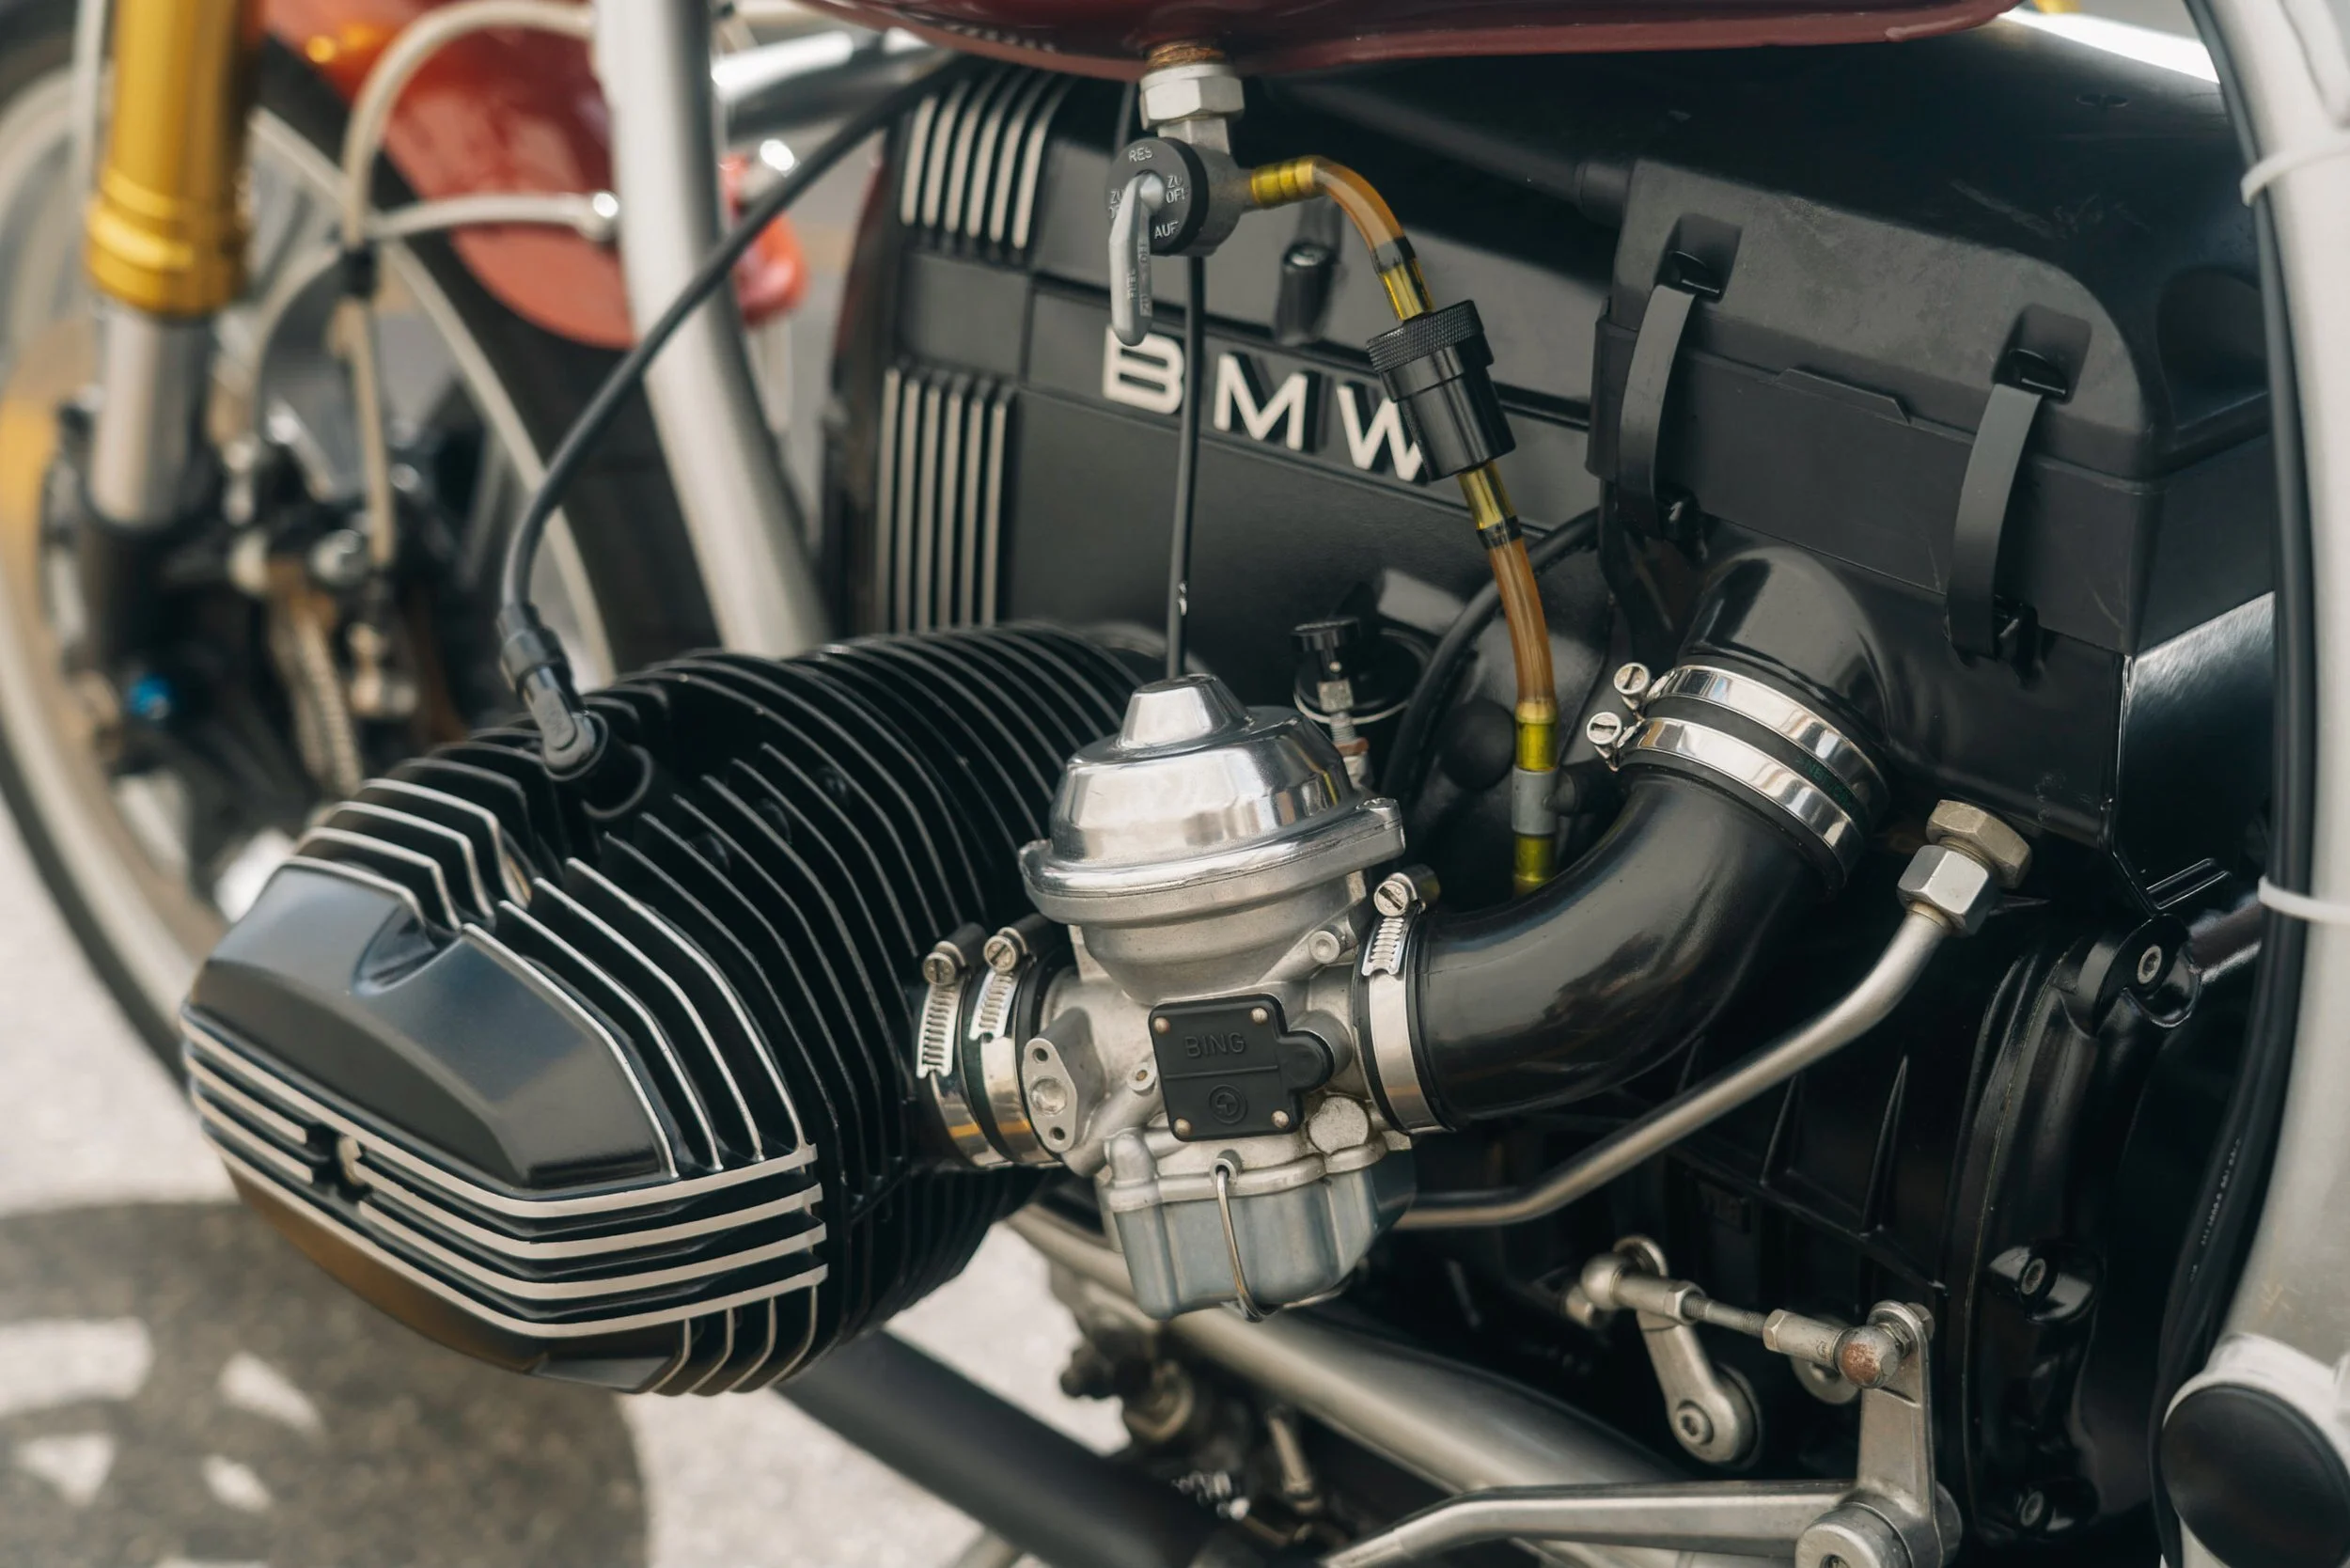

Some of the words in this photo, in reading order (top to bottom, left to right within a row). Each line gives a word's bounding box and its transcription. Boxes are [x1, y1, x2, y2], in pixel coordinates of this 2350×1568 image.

[1128, 146, 1152, 162] RES
[1167, 175, 1183, 188] ZU
[1153, 220, 1179, 240] AUF
[1102, 324, 1423, 482] BMW
[1184, 1032, 1246, 1058] BING
